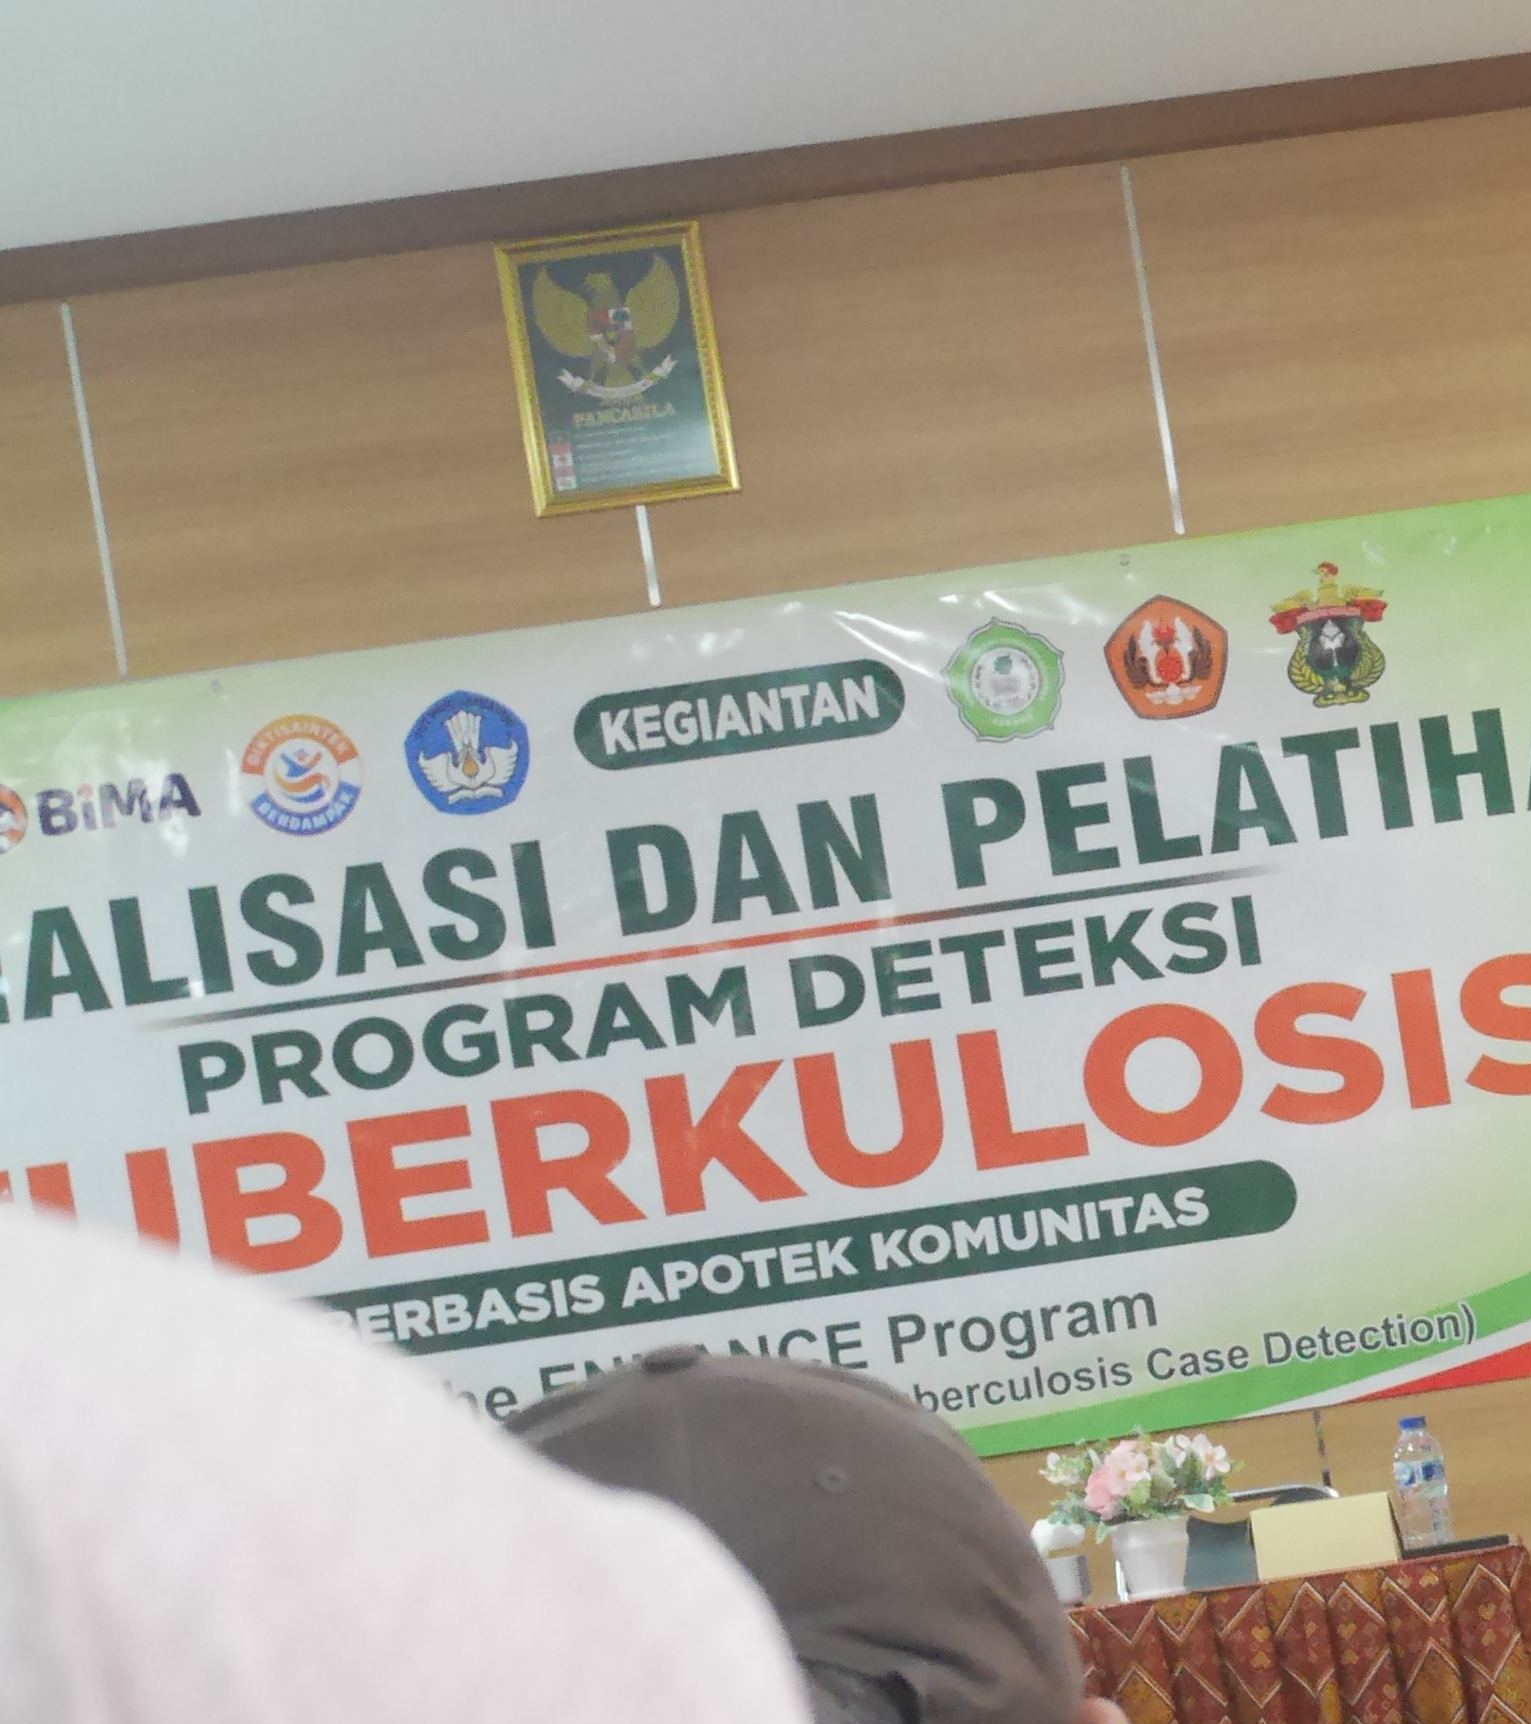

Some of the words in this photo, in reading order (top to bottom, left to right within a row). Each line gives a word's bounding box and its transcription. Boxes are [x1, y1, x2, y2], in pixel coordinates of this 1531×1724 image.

[601, 675, 881, 756] KEGIANTAN
[0, 840, 557, 1024] ALISASI
[606, 792, 893, 937] DAN
[178, 965, 756, 1115] PROGRAM
[789, 894, 1262, 1029] DETEKSI
[622, 1237, 857, 1310] APOTEK
[871, 1186, 1211, 1272] KOMUNITAS
[887, 1291, 1159, 1364] Program
[912, 1354, 1133, 1414] berculosis
[1147, 1337, 1250, 1386] Case
[1264, 1301, 1477, 1368] Detection)
